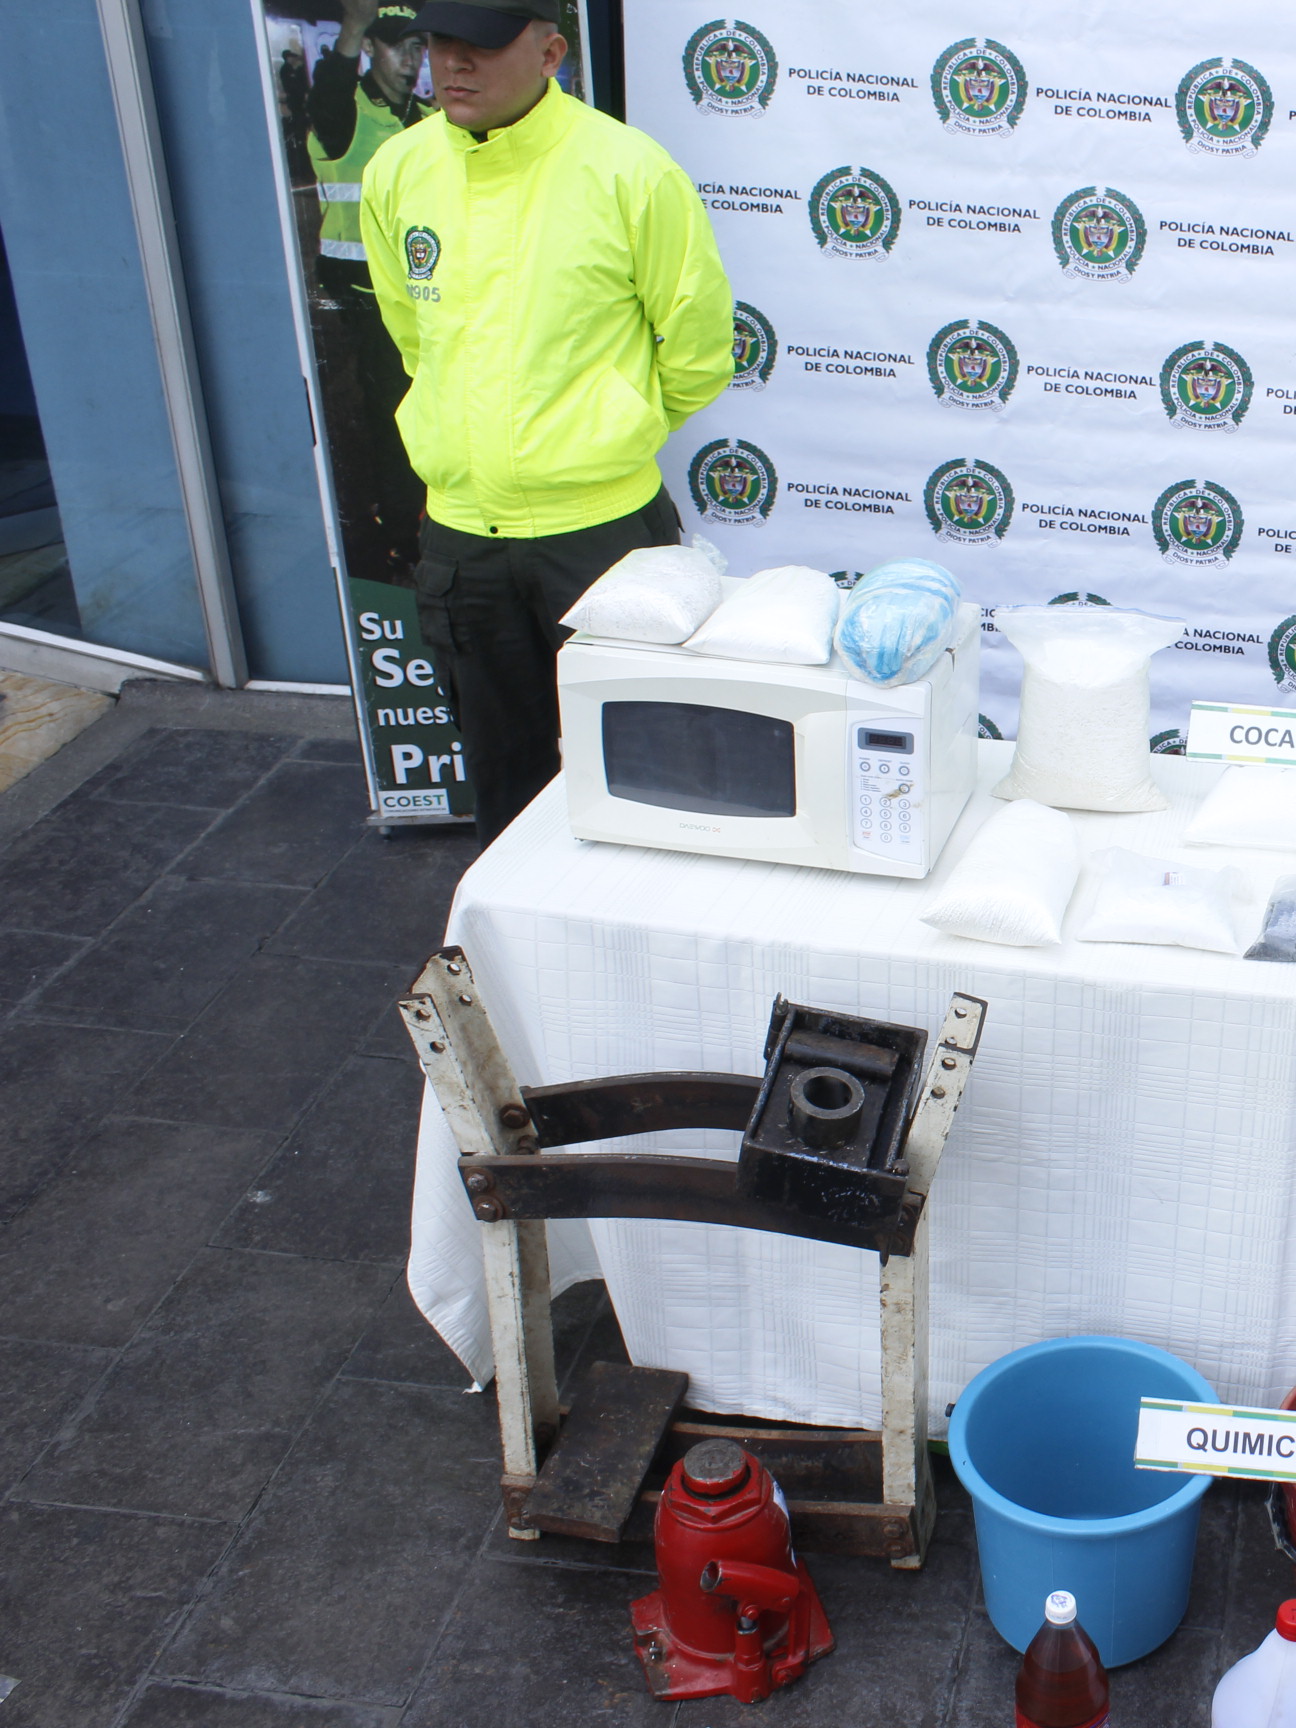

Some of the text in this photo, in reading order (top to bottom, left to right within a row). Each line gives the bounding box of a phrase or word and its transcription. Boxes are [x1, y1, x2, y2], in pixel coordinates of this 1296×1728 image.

[789, 68, 918, 88] POLICÍA NACIONAL
[807, 85, 899, 102] DE COLOMBIA
[1036, 88, 1171, 108] POLICÍA NACIONAL
[1055, 105, 1151, 122] DE COLOMBIA
[729, 186, 802, 200] NACIONAL
[711, 200, 783, 214] COLOMBIA
[909, 200, 1040, 219] POLICÍA NACIONAL
[927, 217, 1021, 233] DE COLOMBIA
[1160, 221, 1294, 242] POLICÍA NACIONAL
[1178, 238, 1274, 255] DE COLOMBIA
[788, 346, 914, 364] POLICÍA NACIONAL
[805, 362, 896, 377] DE COLOMBIA
[1027, 366, 1156, 386] POLICÍA NACIONAL
[1044, 382, 1137, 399] DE COLOMBIA
[788, 483, 911, 502] POLICÍA NACIONAL
[805, 499, 894, 514] DE COLOMBIA
[1022, 503, 1148, 523] POLICÍA NACIONAL
[1039, 519, 1130, 536] DE COLOMBIA
[1275, 543, 1291, 553] DE
[359, 611, 404, 641] Su
[1193, 628, 1264, 644] NACIONAL
[1175, 641, 1245, 656] COLOMBIA
[377, 704, 450, 726] nues
[390, 741, 466, 785] Pri
[384, 794, 445, 808] COEST
